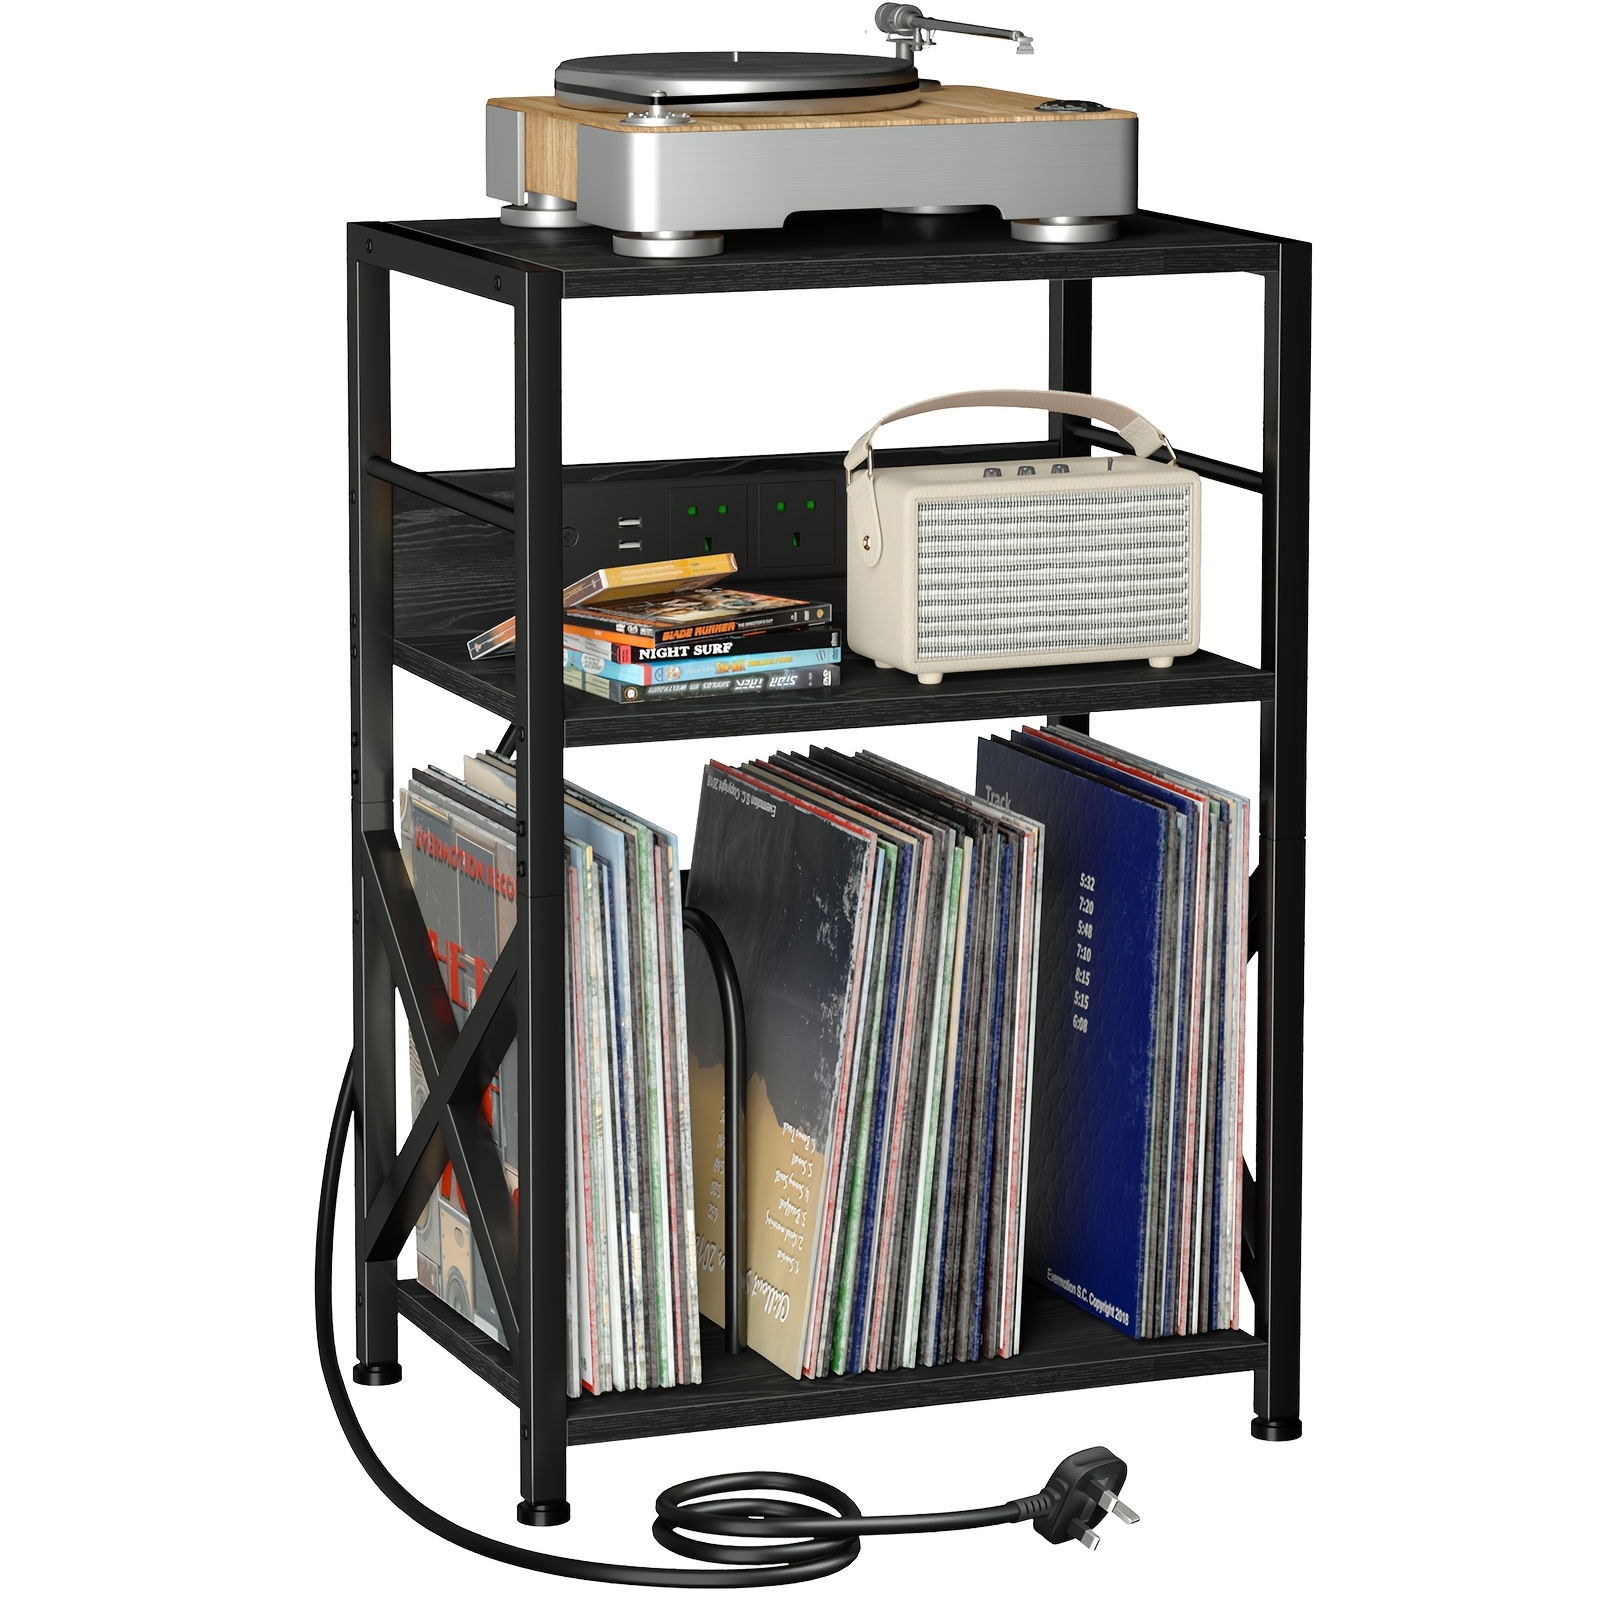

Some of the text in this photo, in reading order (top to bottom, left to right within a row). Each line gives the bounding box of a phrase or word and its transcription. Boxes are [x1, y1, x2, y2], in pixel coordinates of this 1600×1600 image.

[662, 627, 694, 641] BLADE
[694, 621, 736, 637] RUNNER
[639, 645, 690, 660] NIGHT
[693, 642, 733, 656] SURF
[734, 679, 763, 690] TREK
[769, 675, 798, 687] STAR
[985, 784, 1012, 810] Track
[415, 824, 516, 902] EVERMOTION RECO
[1080, 872, 1095, 892] 5:32
[1079, 896, 1094, 915] 7:20
[1077, 919, 1093, 939] 5:48
[1076, 943, 1092, 962] 7:10
[1074, 966, 1091, 987] 8:15
[1073, 990, 1090, 1010] 5:15
[1072, 1014, 1088, 1034] 6:08
[751, 1274, 791, 1323] Chillout
[1046, 1267, 1130, 1326] Evermotion S.C. Copyright 2018
